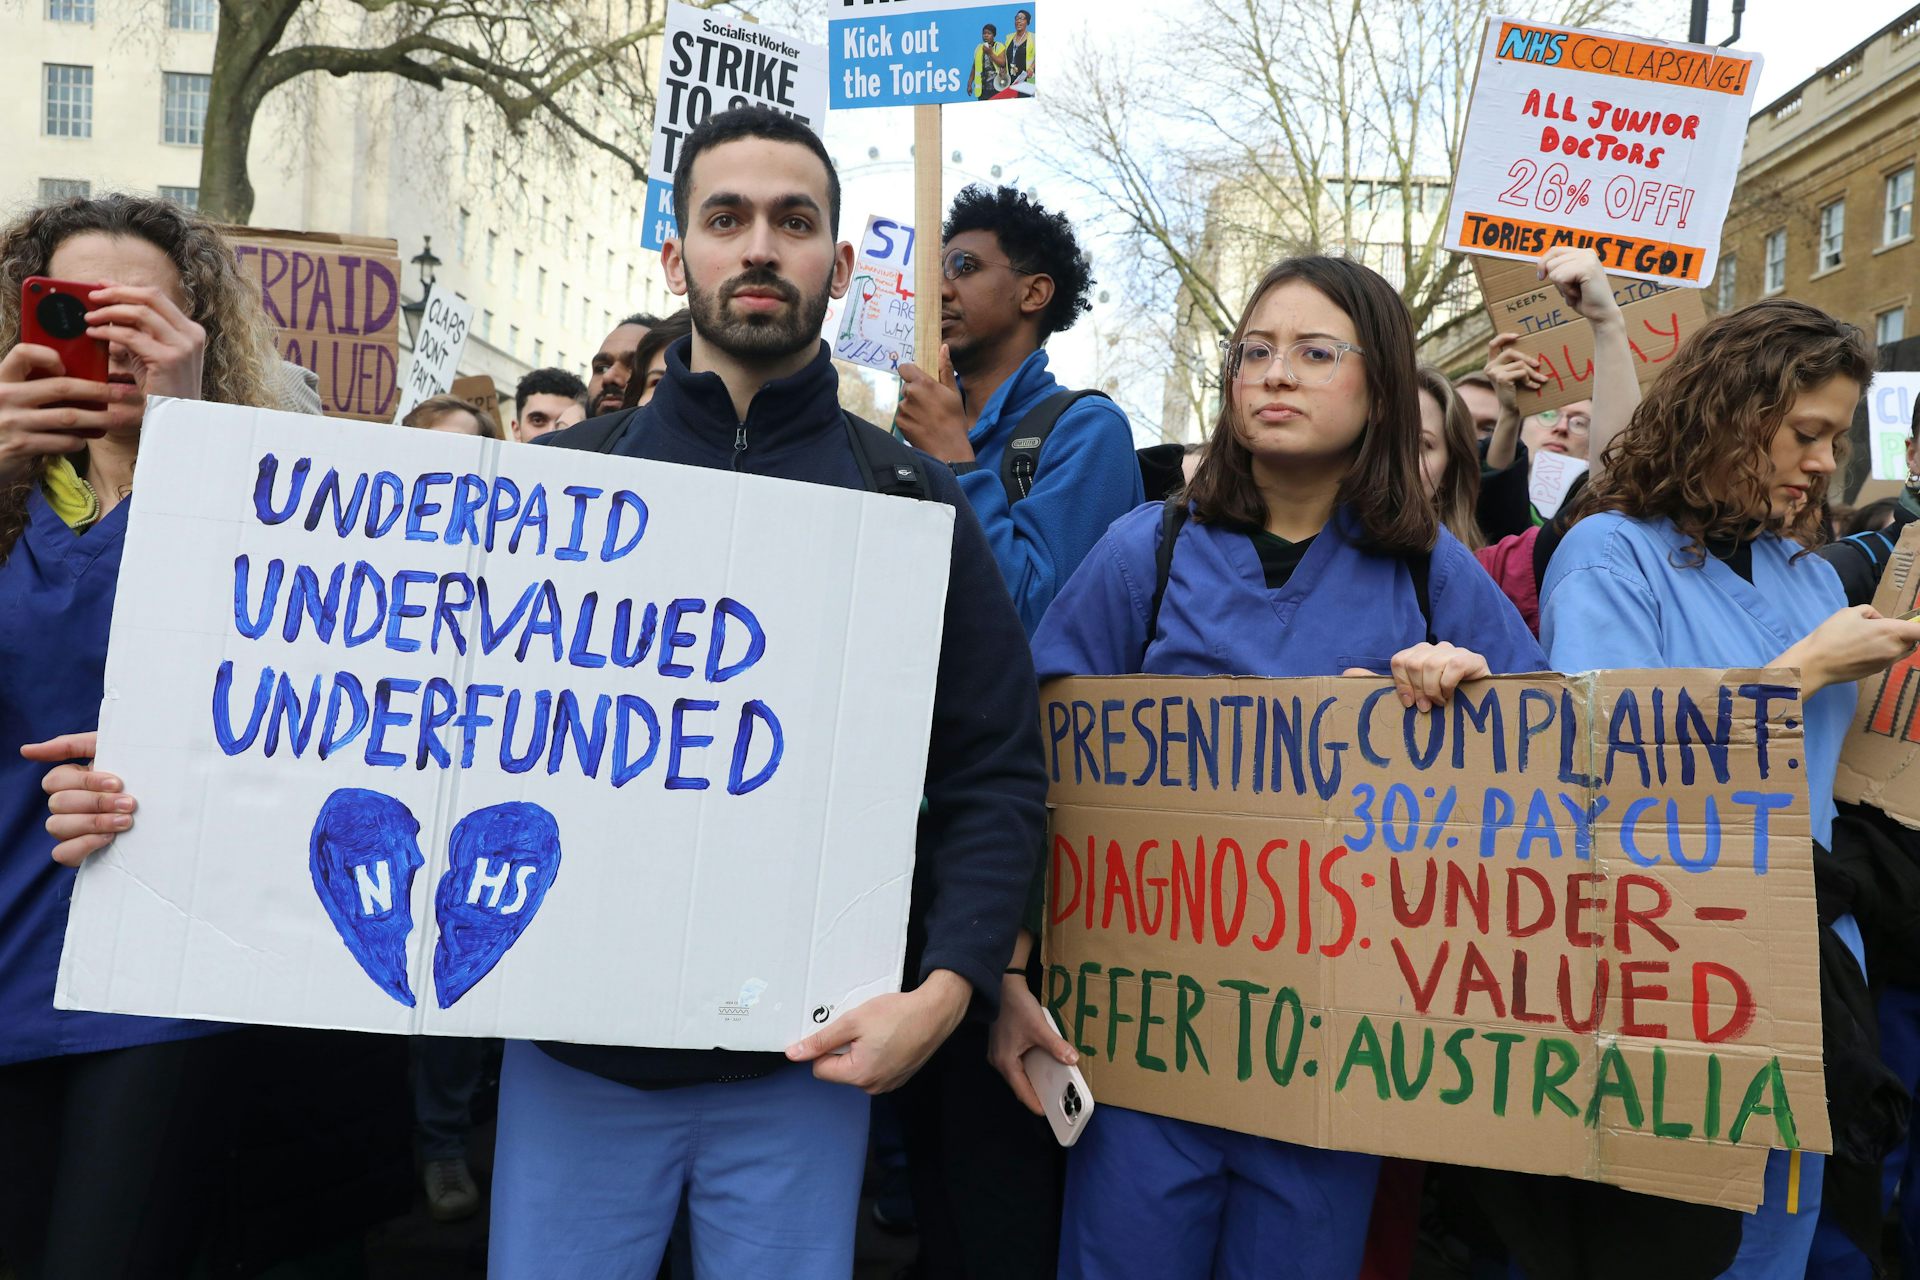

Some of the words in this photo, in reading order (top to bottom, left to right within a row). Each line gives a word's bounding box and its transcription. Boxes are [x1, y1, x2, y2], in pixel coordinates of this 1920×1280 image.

[702, 18, 758, 46] Socialist
[758, 33, 800, 59] Worker
[843, 24, 893, 59] Kick
[901, 21, 939, 55] out
[1498, 28, 1568, 66] NHS
[1571, 38, 1747, 92] COLLAPSING!
[669, 30, 799, 108] STRIKE
[843, 66, 881, 99] the
[889, 61, 960, 96] Tories
[666, 77, 712, 131] TO
[1521, 88, 1577, 122] ALL
[1587, 101, 1700, 140] JUNIOR
[1540, 126, 1665, 169] DOCTORS
[1498, 158, 1592, 214] 26%
[1604, 174, 1695, 229] OFF!
[1467, 215, 1546, 252] TORIES
[1634, 245, 1694, 277] GO!
[429, 298, 465, 345] CLAPS
[884, 321, 913, 342] WHY
[1507, 292, 1547, 314] KEEPS
[1518, 309, 1569, 334] THE
[410, 359, 429, 394] PAY
[1530, 450, 1564, 504] PAY
[255, 453, 648, 562] UNDERPAID
[234, 555, 767, 683] UNDERVALUED
[212, 660, 785, 796] UNDERFUNDED
[1048, 694, 1349, 801] PRESENTING
[1357, 685, 1799, 788] COMPLAINT:
[1343, 782, 1459, 853] 30%
[1480, 787, 1609, 861] PAY
[1619, 791, 1796, 875] CUT
[1051, 835, 1376, 958] DIAGNOSIS:
[1389, 857, 1748, 954] UNDER-
[1391, 938, 1758, 1044] VALUED
[1047, 961, 1211, 1075] REFER
[1217, 979, 1323, 1088] TO:
[1334, 1015, 1801, 1150] AUSTRALIA
